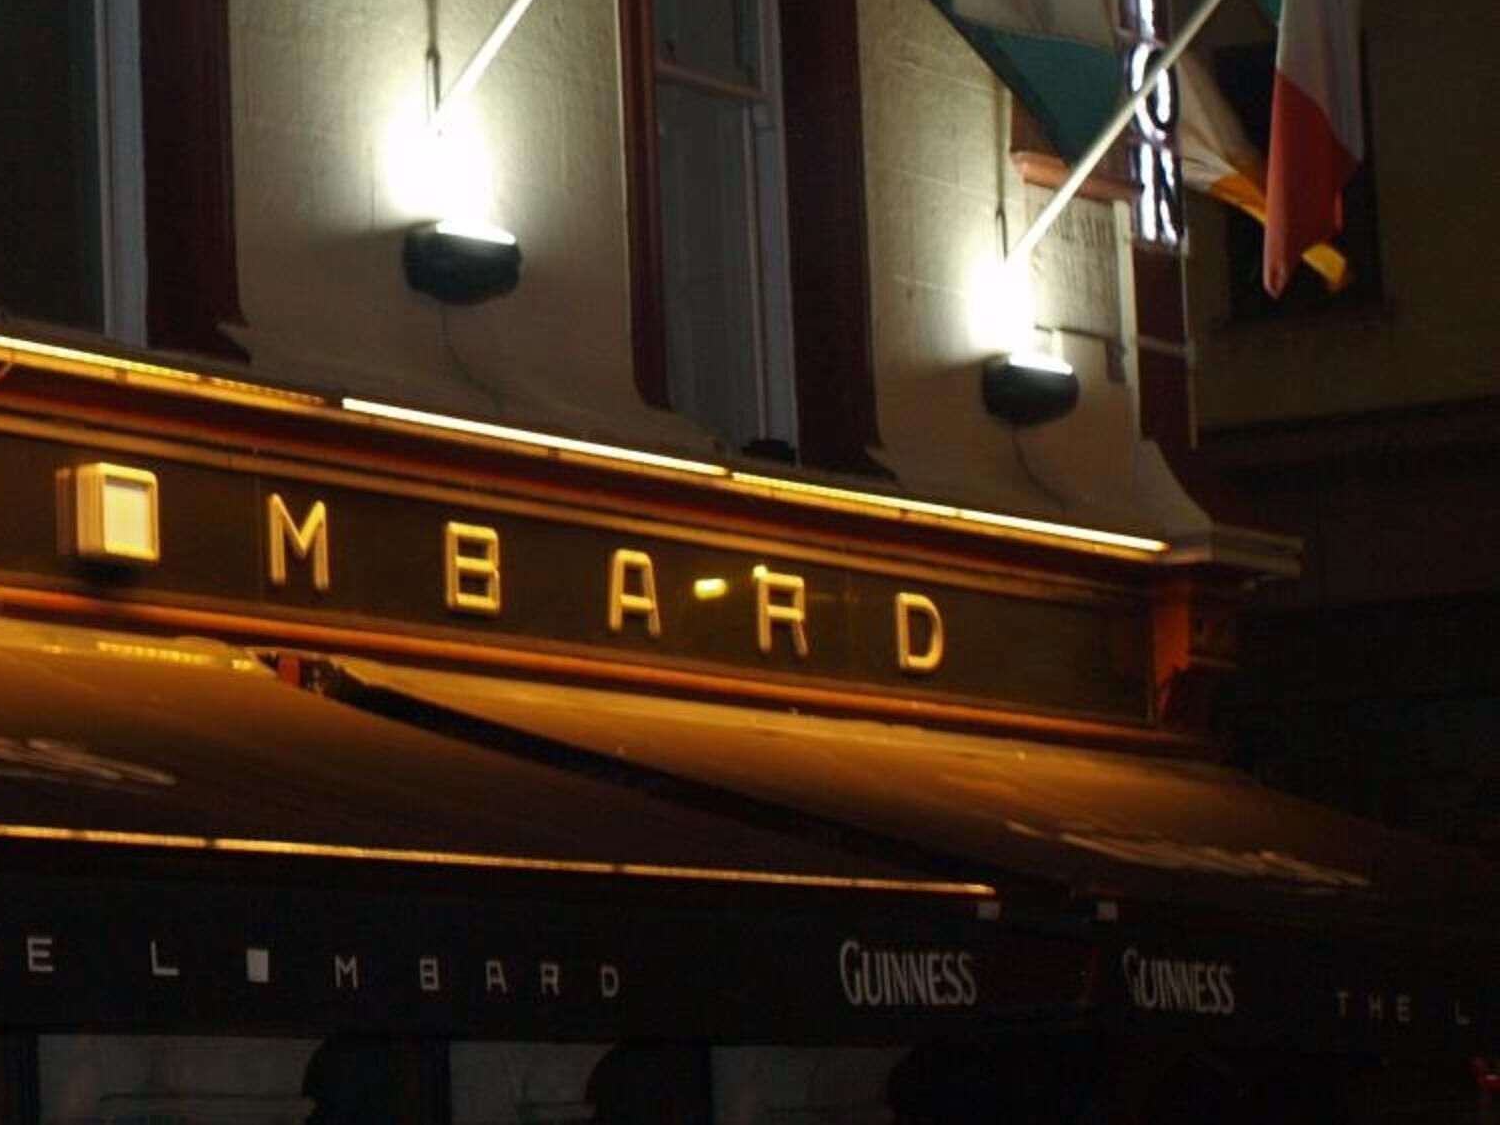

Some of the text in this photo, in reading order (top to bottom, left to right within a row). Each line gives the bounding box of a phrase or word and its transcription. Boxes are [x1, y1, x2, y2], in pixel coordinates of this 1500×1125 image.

[839, 938, 978, 1007] GUINNESS
[1123, 947, 1235, 1015] GUINNESS
[1335, 990, 1413, 1022] THE
